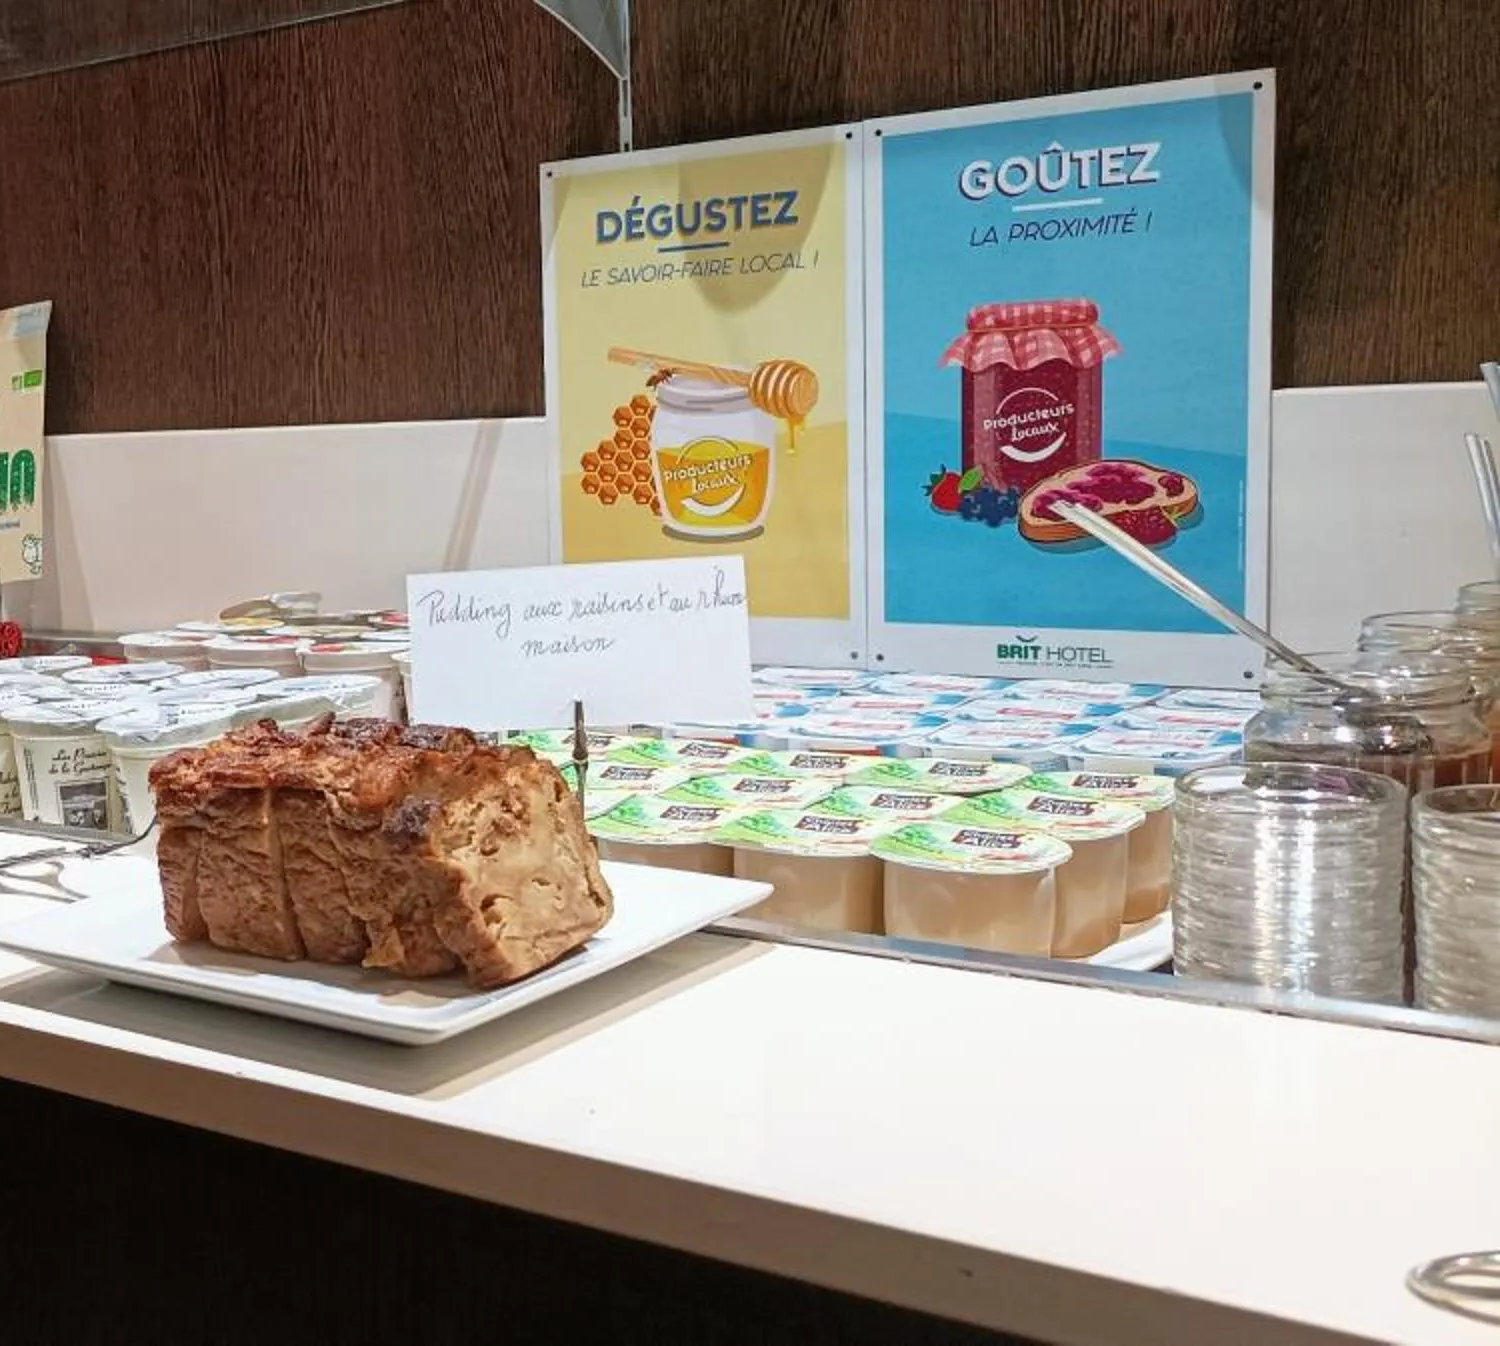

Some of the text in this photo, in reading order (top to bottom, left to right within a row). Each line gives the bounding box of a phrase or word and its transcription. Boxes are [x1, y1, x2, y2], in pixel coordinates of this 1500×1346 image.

[959, 140, 1162, 200] GOÛTEZ
[596, 190, 799, 244] DÉGUSTEZ
[969, 226, 999, 247] LA
[1008, 207, 1137, 242] PROXIMITÉ
[581, 268, 600, 288] LE
[607, 257, 734, 286] SAVOIR-FAIRE
[740, 252, 805, 275] LOCAL
[416, 589, 512, 639] Pudding
[523, 601, 563, 622] aux
[520, 633, 618, 658] maison
[997, 643, 1114, 663] BRIT HOTEL
